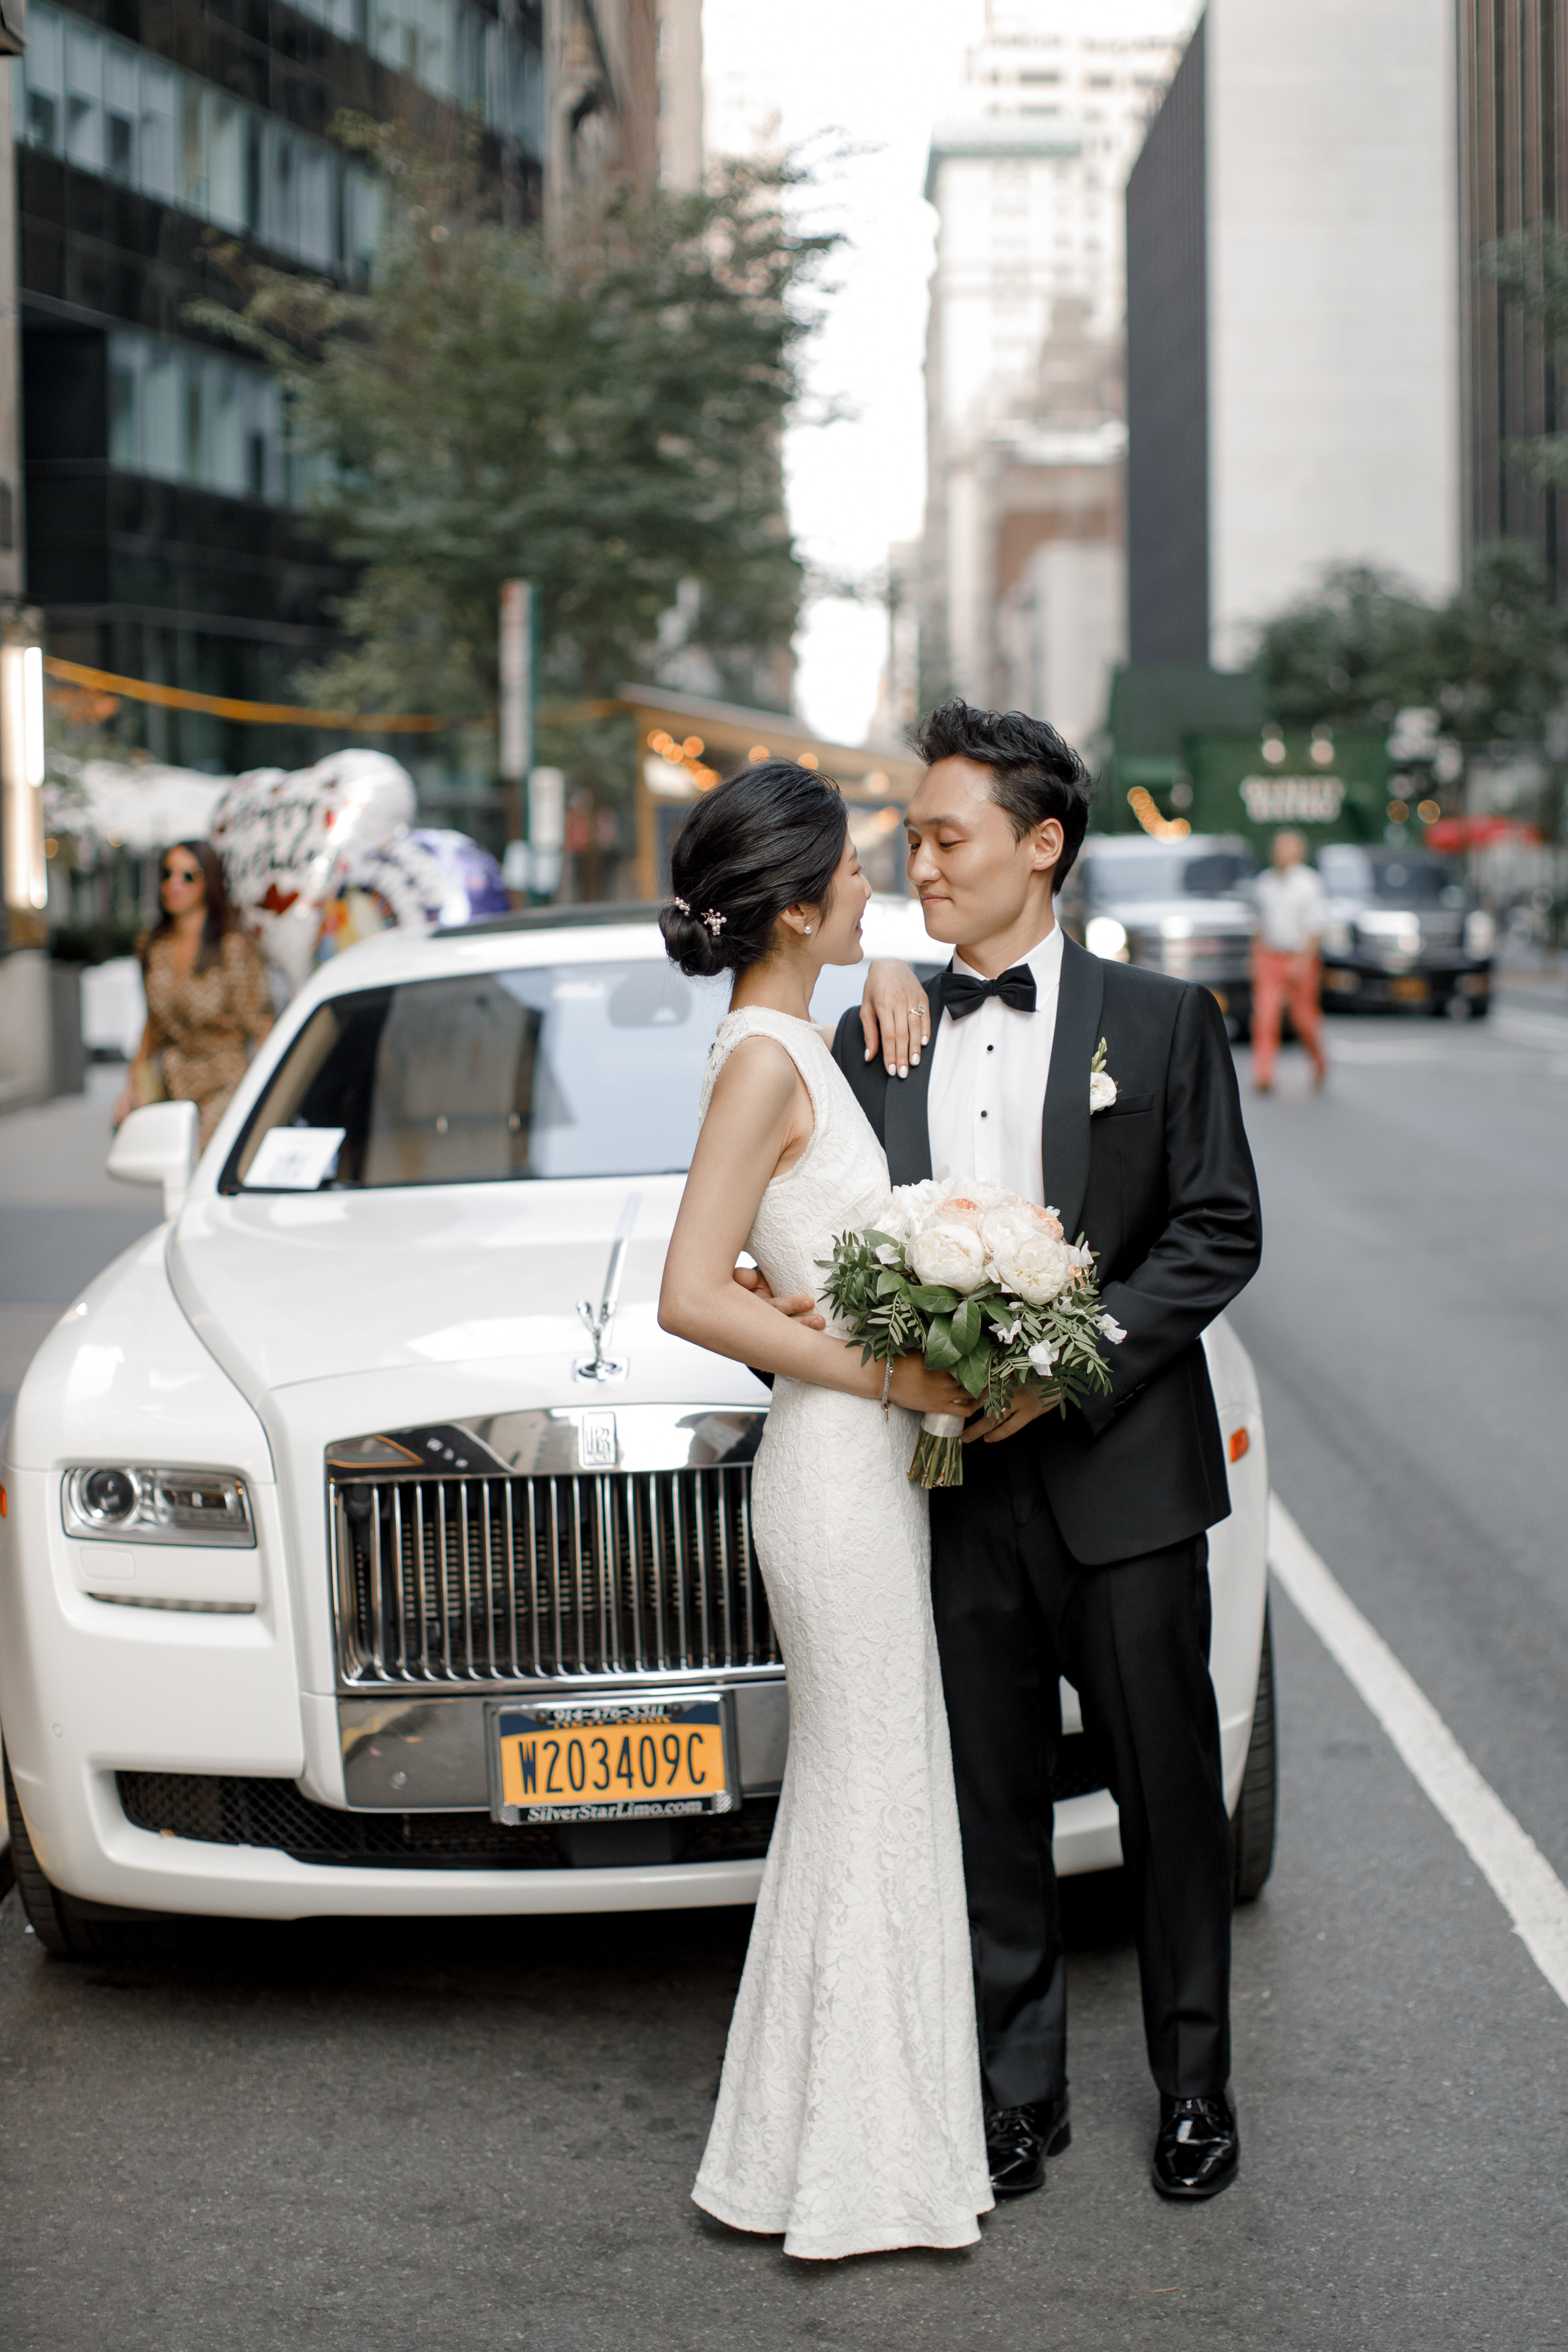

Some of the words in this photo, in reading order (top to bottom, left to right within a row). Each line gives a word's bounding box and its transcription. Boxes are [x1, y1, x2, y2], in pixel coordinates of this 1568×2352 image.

[553, 1705, 664, 1722] 914-476-3311
[518, 1733, 706, 1794] W203409C
[527, 1801, 702, 1822] SilverStarLimo.com
